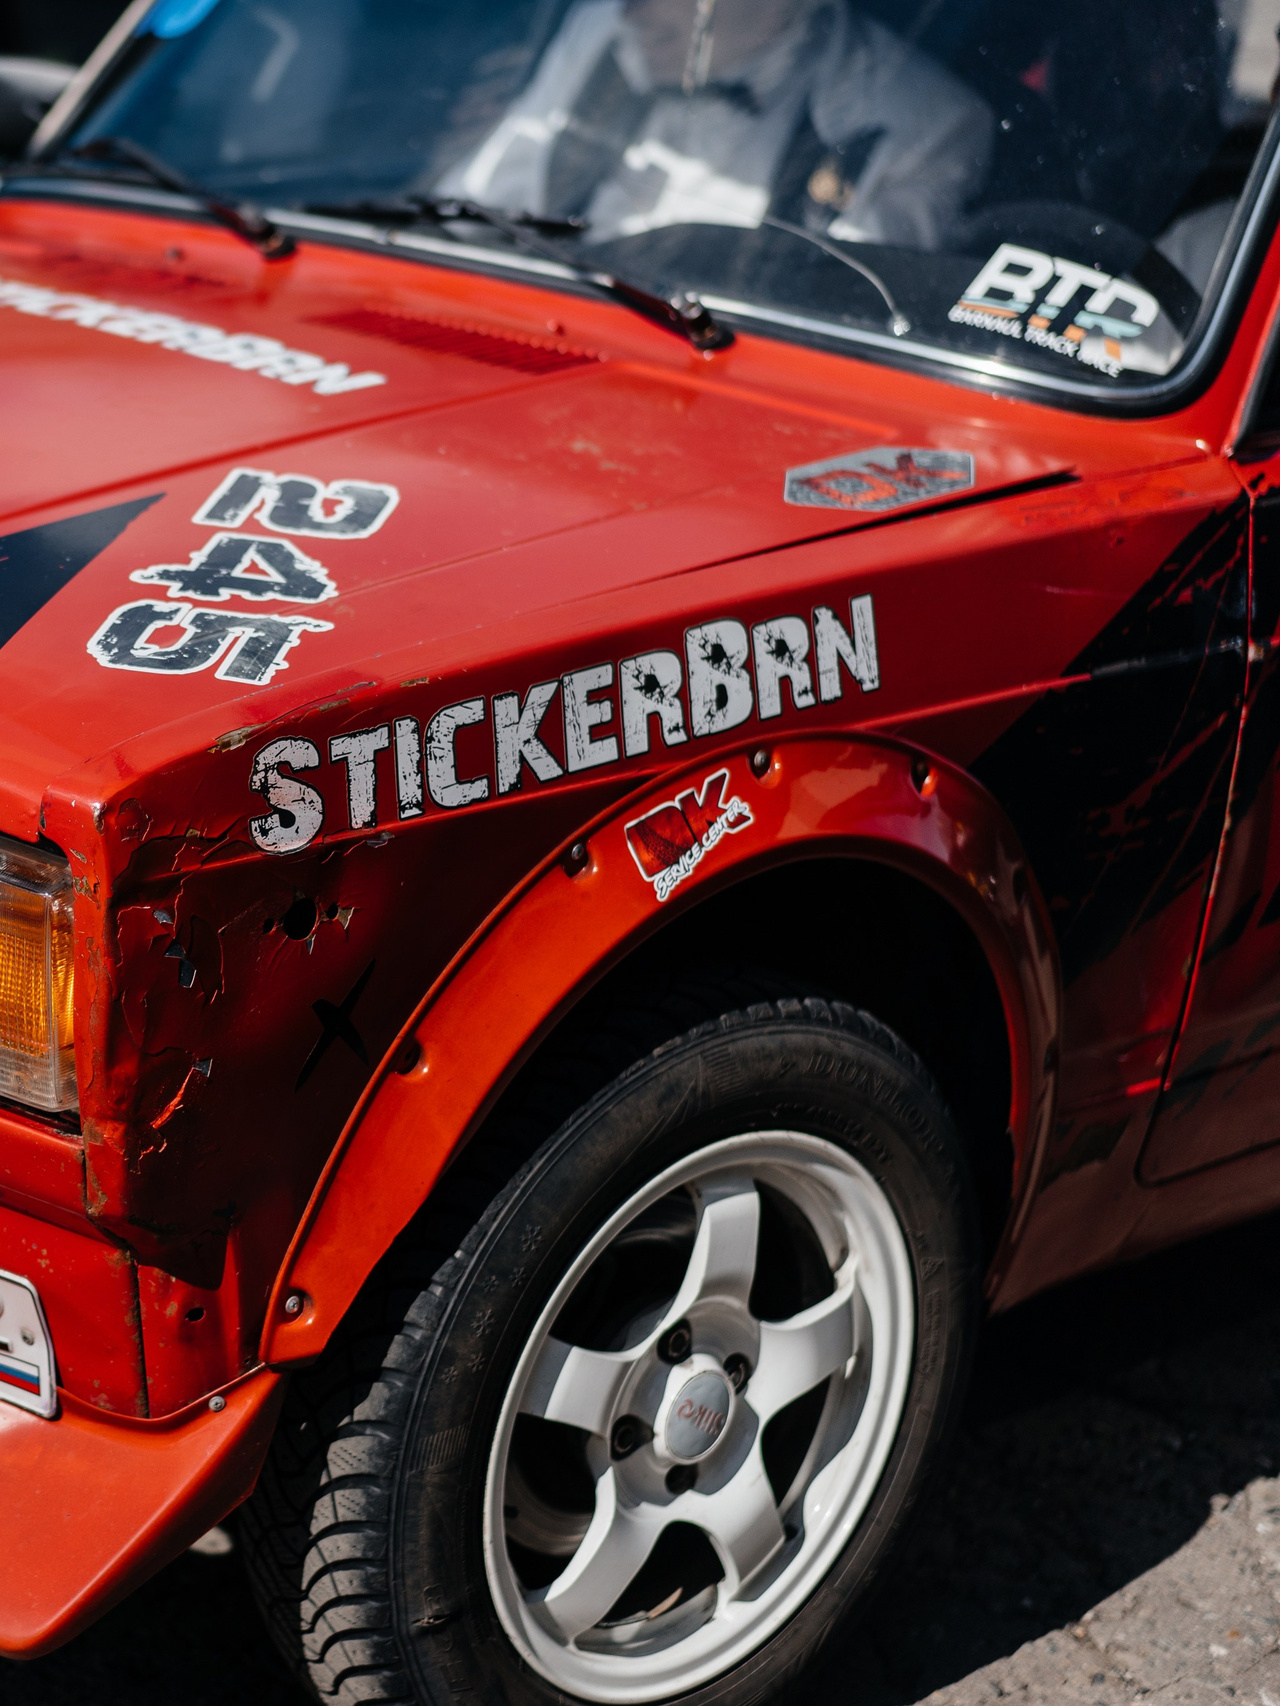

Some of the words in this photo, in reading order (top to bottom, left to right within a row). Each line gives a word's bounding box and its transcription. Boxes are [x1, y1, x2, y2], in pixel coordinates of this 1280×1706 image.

[86, 466, 401, 686] 245
[248, 594, 881, 855] STICKERBRN
[654, 841, 703, 902] SERVICE
[701, 798, 749, 851] CENTER
